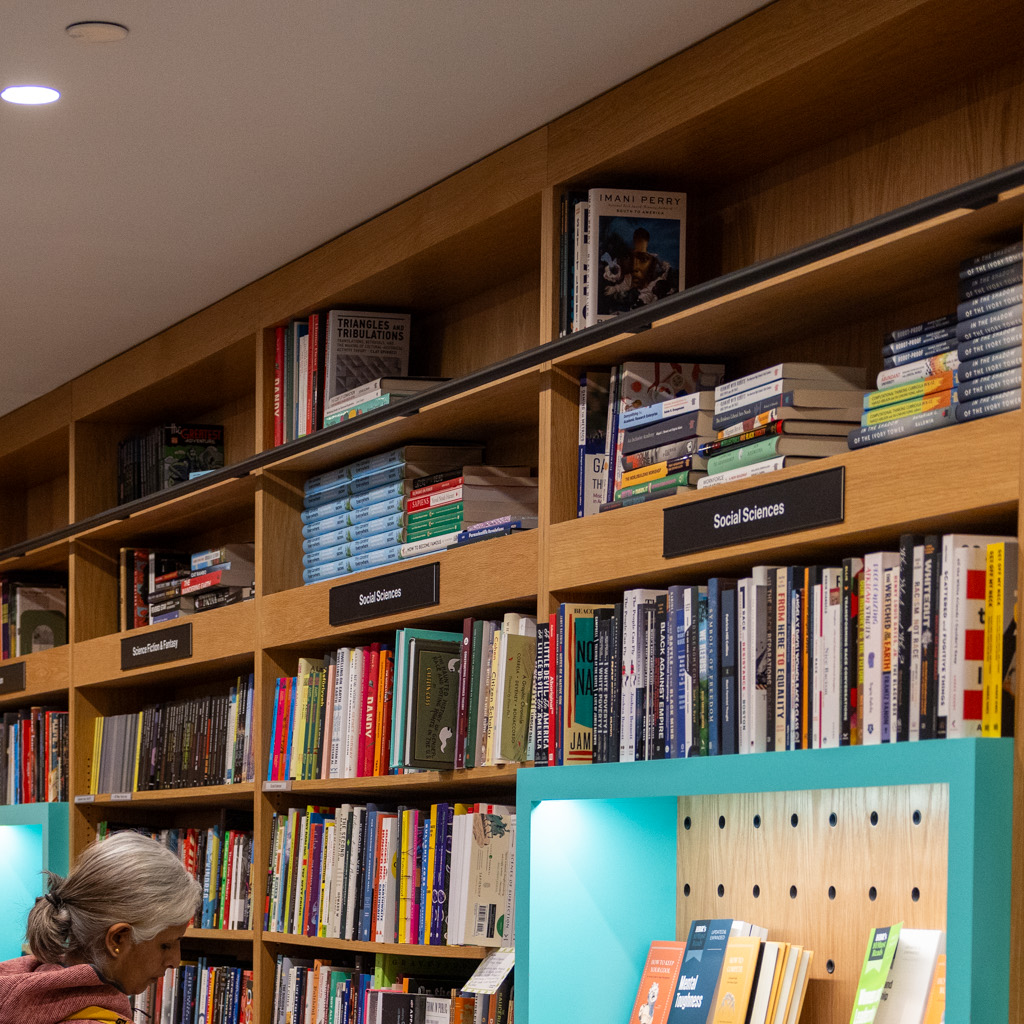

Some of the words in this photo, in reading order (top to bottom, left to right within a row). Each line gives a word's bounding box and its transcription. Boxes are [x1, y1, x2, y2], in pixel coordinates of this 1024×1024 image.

[599, 194, 635, 203] IMANI
[640, 195, 681, 206] PERRY
[967, 268, 973, 276] OF
[975, 265, 987, 274] THE
[988, 260, 1002, 271] IVORY
[964, 310, 972, 318] OF
[974, 307, 985, 315] THE
[987, 303, 1001, 312] IVORY
[978, 318, 989, 327] THE
[991, 311, 1013, 323] SHADOW
[338, 318, 390, 331] TRIANGLES
[337, 327, 404, 341] TRIBULATIONS
[972, 406, 983, 415] THE
[984, 403, 999, 413] IVORY
[181, 428, 222, 441] GREATEST
[854, 437, 860, 445] OF
[861, 435, 870, 443] THE
[872, 431, 886, 441] IVORY
[886, 427, 905, 438] TOWER
[411, 496, 430, 509] SAPIENS
[713, 509, 741, 528] Social
[742, 502, 785, 523] Sciences
[359, 593, 376, 606] Social
[376, 588, 401, 601] Sciences
[922, 559, 932, 628] WHITEOUT
[778, 592, 786, 621] FROM
[777, 624, 786, 649] HERE
[132, 646, 147, 656] Science
[147, 643, 159, 653] Fiction
[163, 639, 178, 650] Fantasy
[883, 641, 891, 670] EARTH
[777, 652, 785, 665] TO
[707, 673, 715, 722] FREEDOM
[776, 668, 785, 719] EQUALITY
[678, 974, 700, 991] Mental
[674, 992, 704, 1010] Toughness
